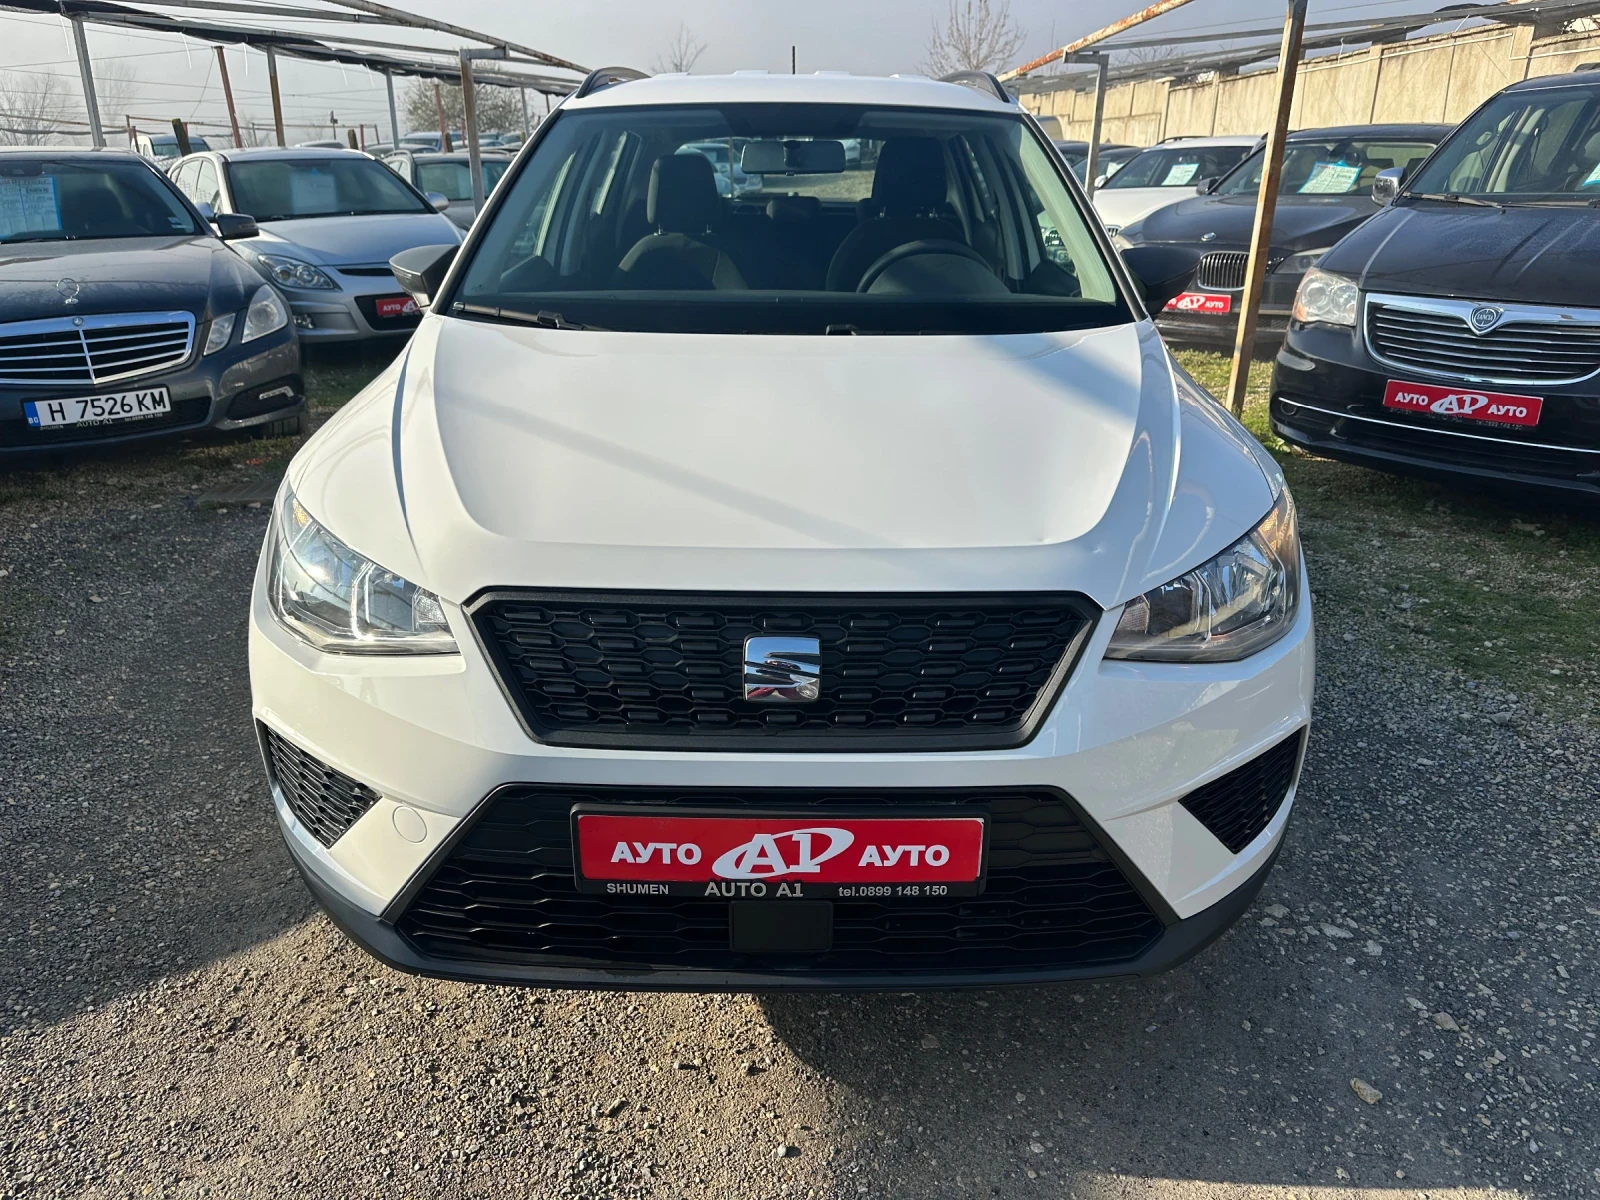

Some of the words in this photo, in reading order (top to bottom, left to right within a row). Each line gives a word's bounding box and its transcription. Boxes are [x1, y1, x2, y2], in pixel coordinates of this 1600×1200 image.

[1205, 301, 1224, 309] АУТО
[48, 403, 66, 421] H
[76, 396, 132, 419] 7526
[136, 391, 166, 412] KM
[1395, 392, 1429, 406] АУТО
[1487, 405, 1527, 418] АУТО
[28, 416, 39, 424] BG
[76, 419, 100, 428] AUTO
[611, 841, 702, 865] АУТО
[858, 845, 950, 867] АУТО
[606, 883, 669, 895] SHUMEN
[704, 882, 766, 897] AUTO
[776, 883, 804, 897] A1
[838, 886, 892, 897] tel.0899
[896, 886, 920, 896] 148
[924, 885, 948, 896] 150
